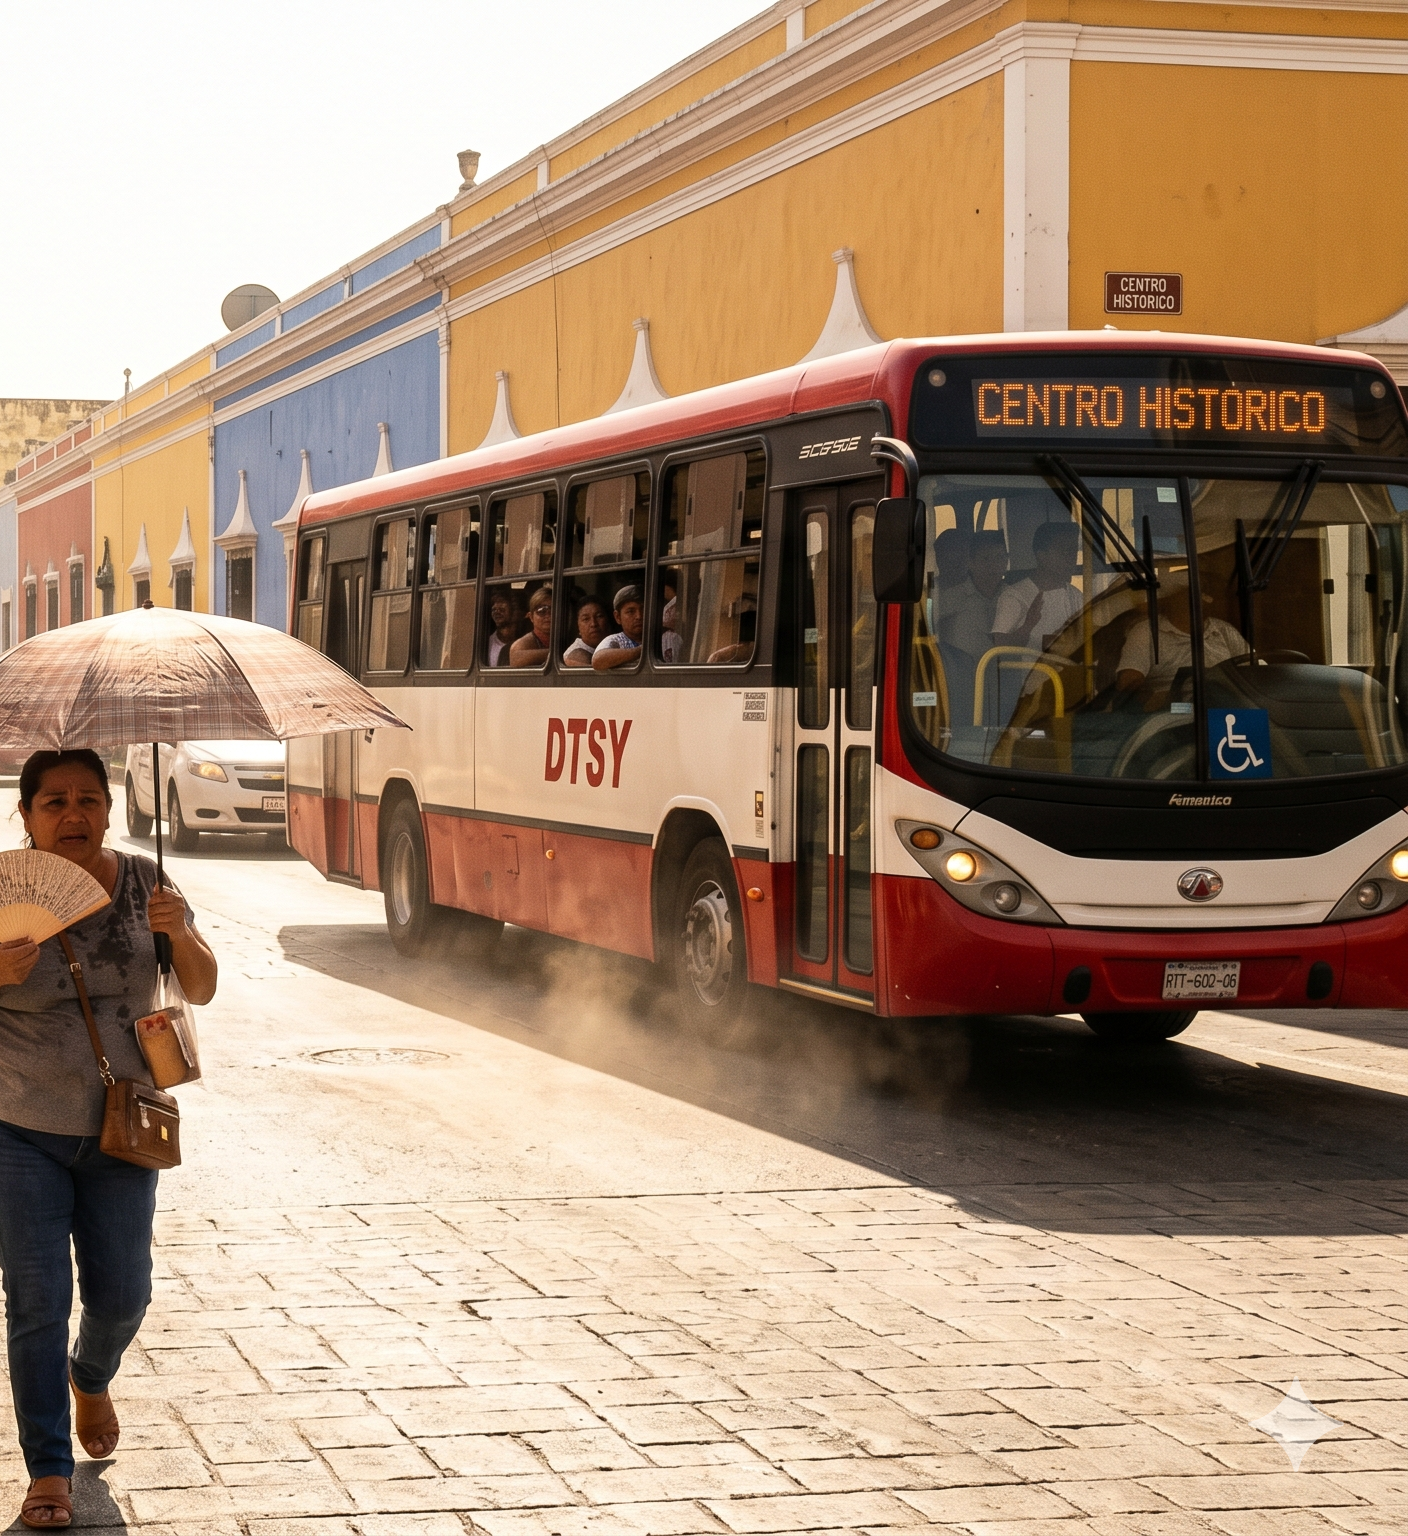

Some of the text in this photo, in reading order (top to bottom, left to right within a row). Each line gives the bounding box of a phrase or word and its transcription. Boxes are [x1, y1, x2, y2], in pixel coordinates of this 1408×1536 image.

[1120, 277, 1167, 292] CENTRO
[1113, 294, 1175, 310] HISTORICO
[977, 382, 1326, 433] CENTRO HISTORICO
[544, 717, 634, 789] DTSY
